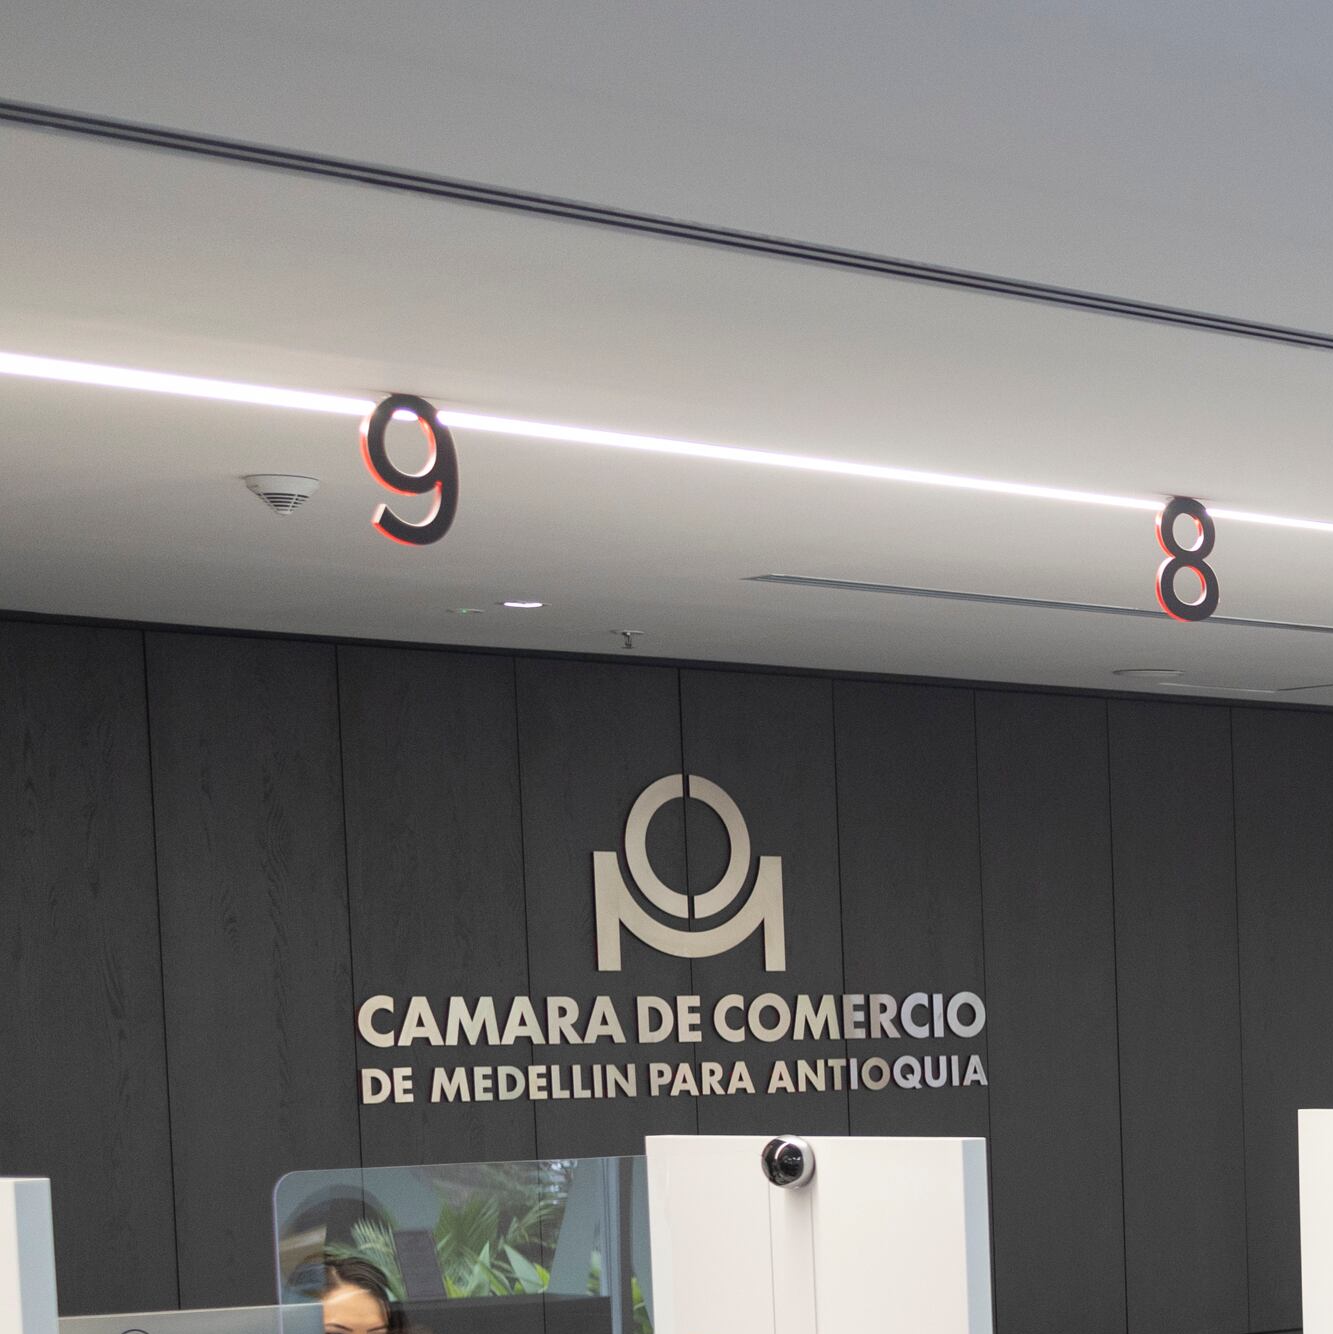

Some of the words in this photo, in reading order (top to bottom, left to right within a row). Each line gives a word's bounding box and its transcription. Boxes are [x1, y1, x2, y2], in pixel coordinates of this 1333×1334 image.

[360, 393, 459, 546] 9
[1155, 496, 1220, 623] 8
[357, 995, 627, 1048] CAMARA
[636, 995, 702, 1043] DE
[713, 991, 986, 1042] COMERCIO
[361, 1067, 414, 1104] DE
[431, 1063, 637, 1103] MEDELLIN
[649, 1061, 756, 1097] PARA
[767, 1054, 988, 1094] ANTIOQUIA
